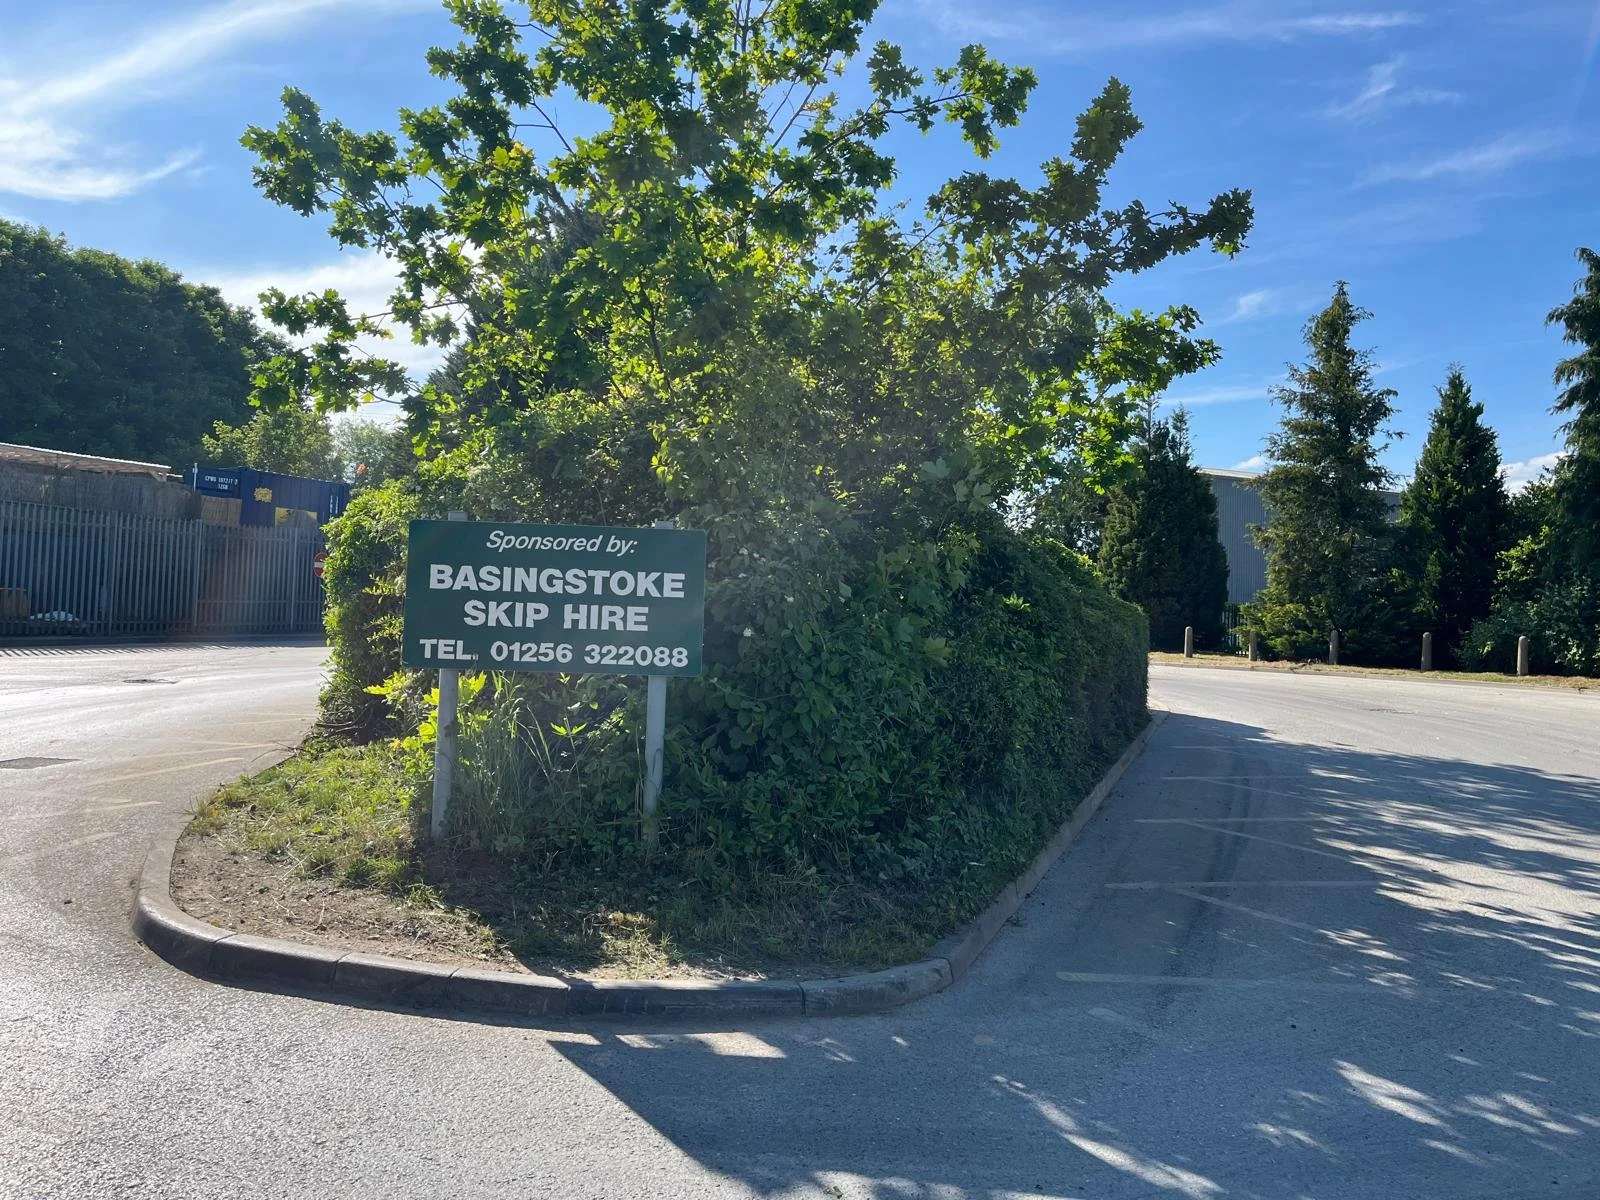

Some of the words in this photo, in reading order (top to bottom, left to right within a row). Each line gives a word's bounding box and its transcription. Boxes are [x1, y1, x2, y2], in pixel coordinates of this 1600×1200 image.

[486, 529, 603, 552] Sponsored
[605, 535, 638, 557] by:
[429, 563, 686, 598] BASINGSTOKE
[463, 599, 549, 628] SKIP
[563, 604, 649, 631] HIRE
[419, 638, 479, 661] TEL.
[490, 641, 573, 664] 01256
[584, 644, 689, 668] 322088
